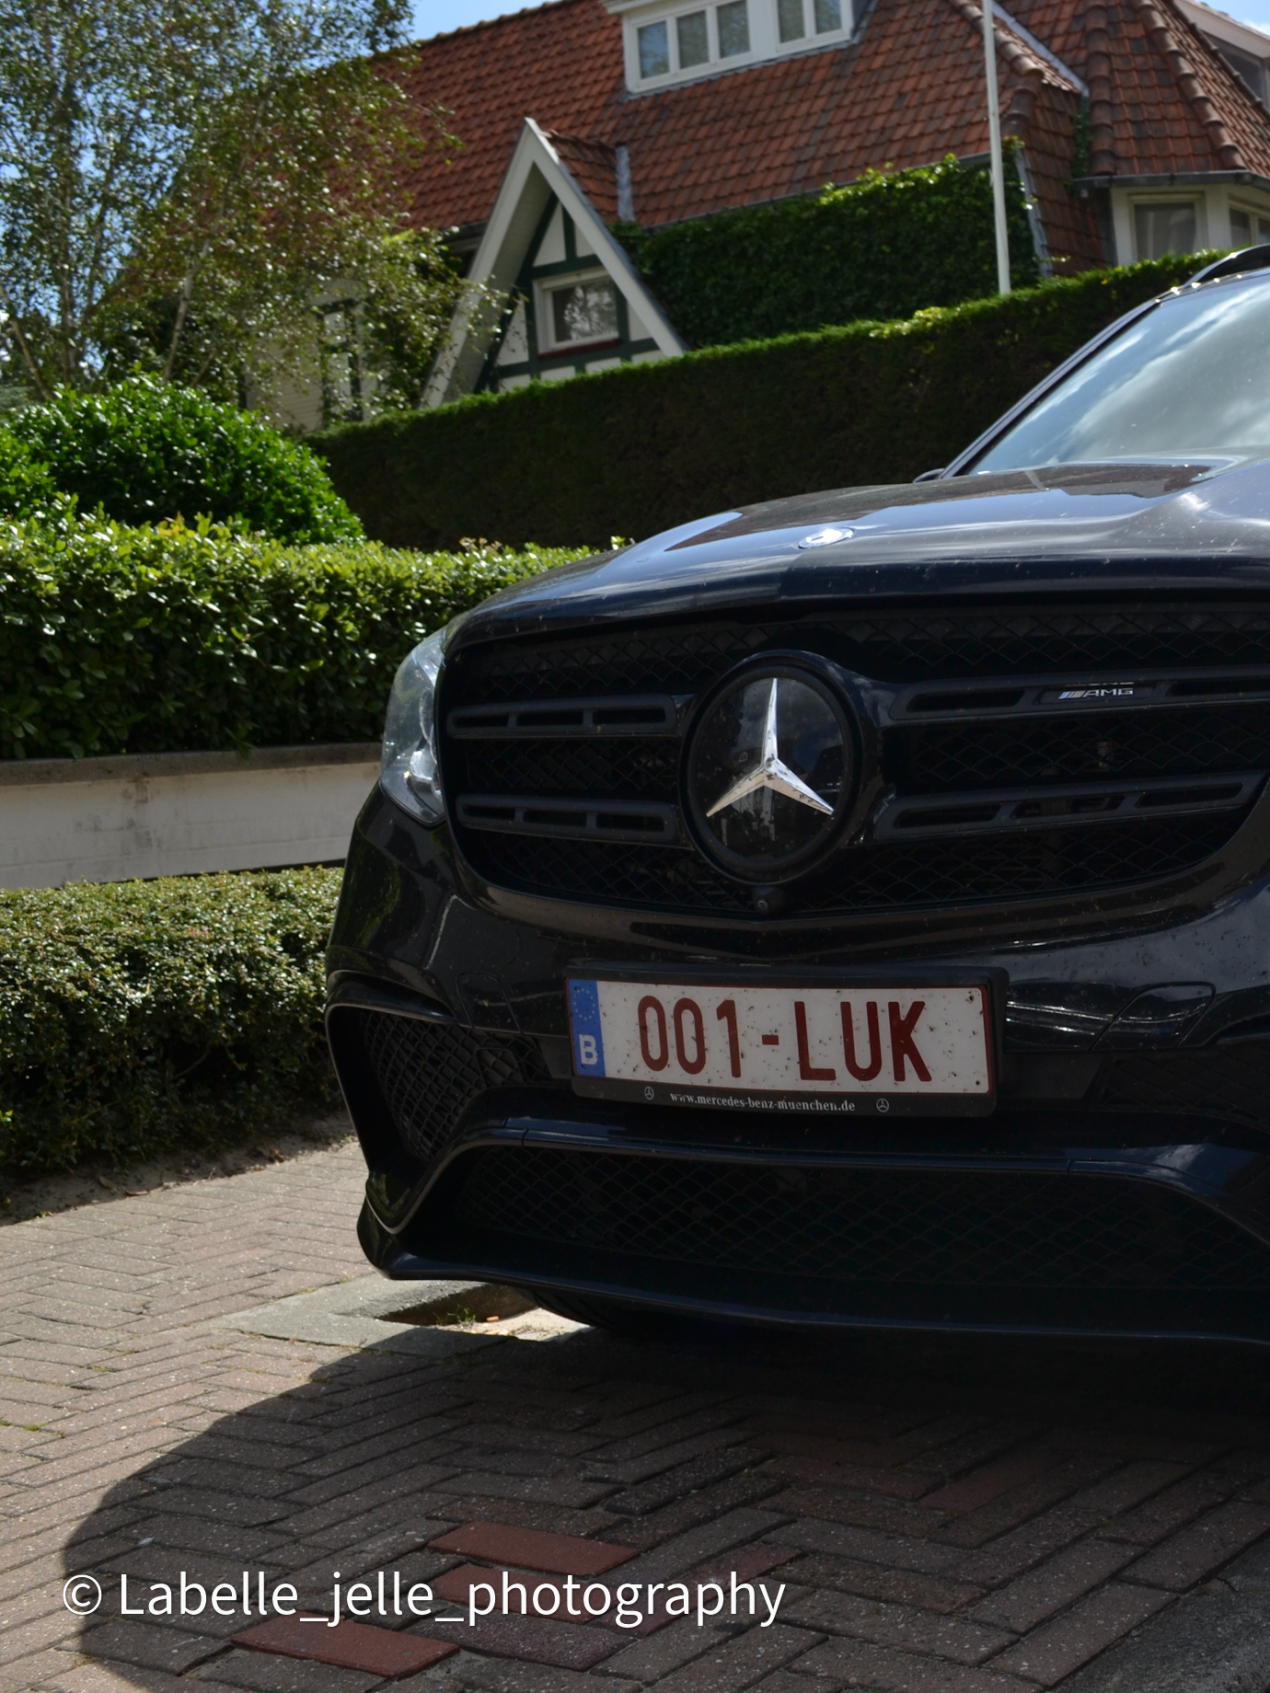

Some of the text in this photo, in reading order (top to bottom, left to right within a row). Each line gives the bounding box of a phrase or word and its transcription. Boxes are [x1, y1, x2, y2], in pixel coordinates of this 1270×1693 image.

[1083, 688, 1134, 698] AMG
[579, 1034, 598, 1065] B
[637, 995, 932, 1082] 001-LUK
[670, 1092, 856, 1112] www.mercedes-benz-muenchen.de
